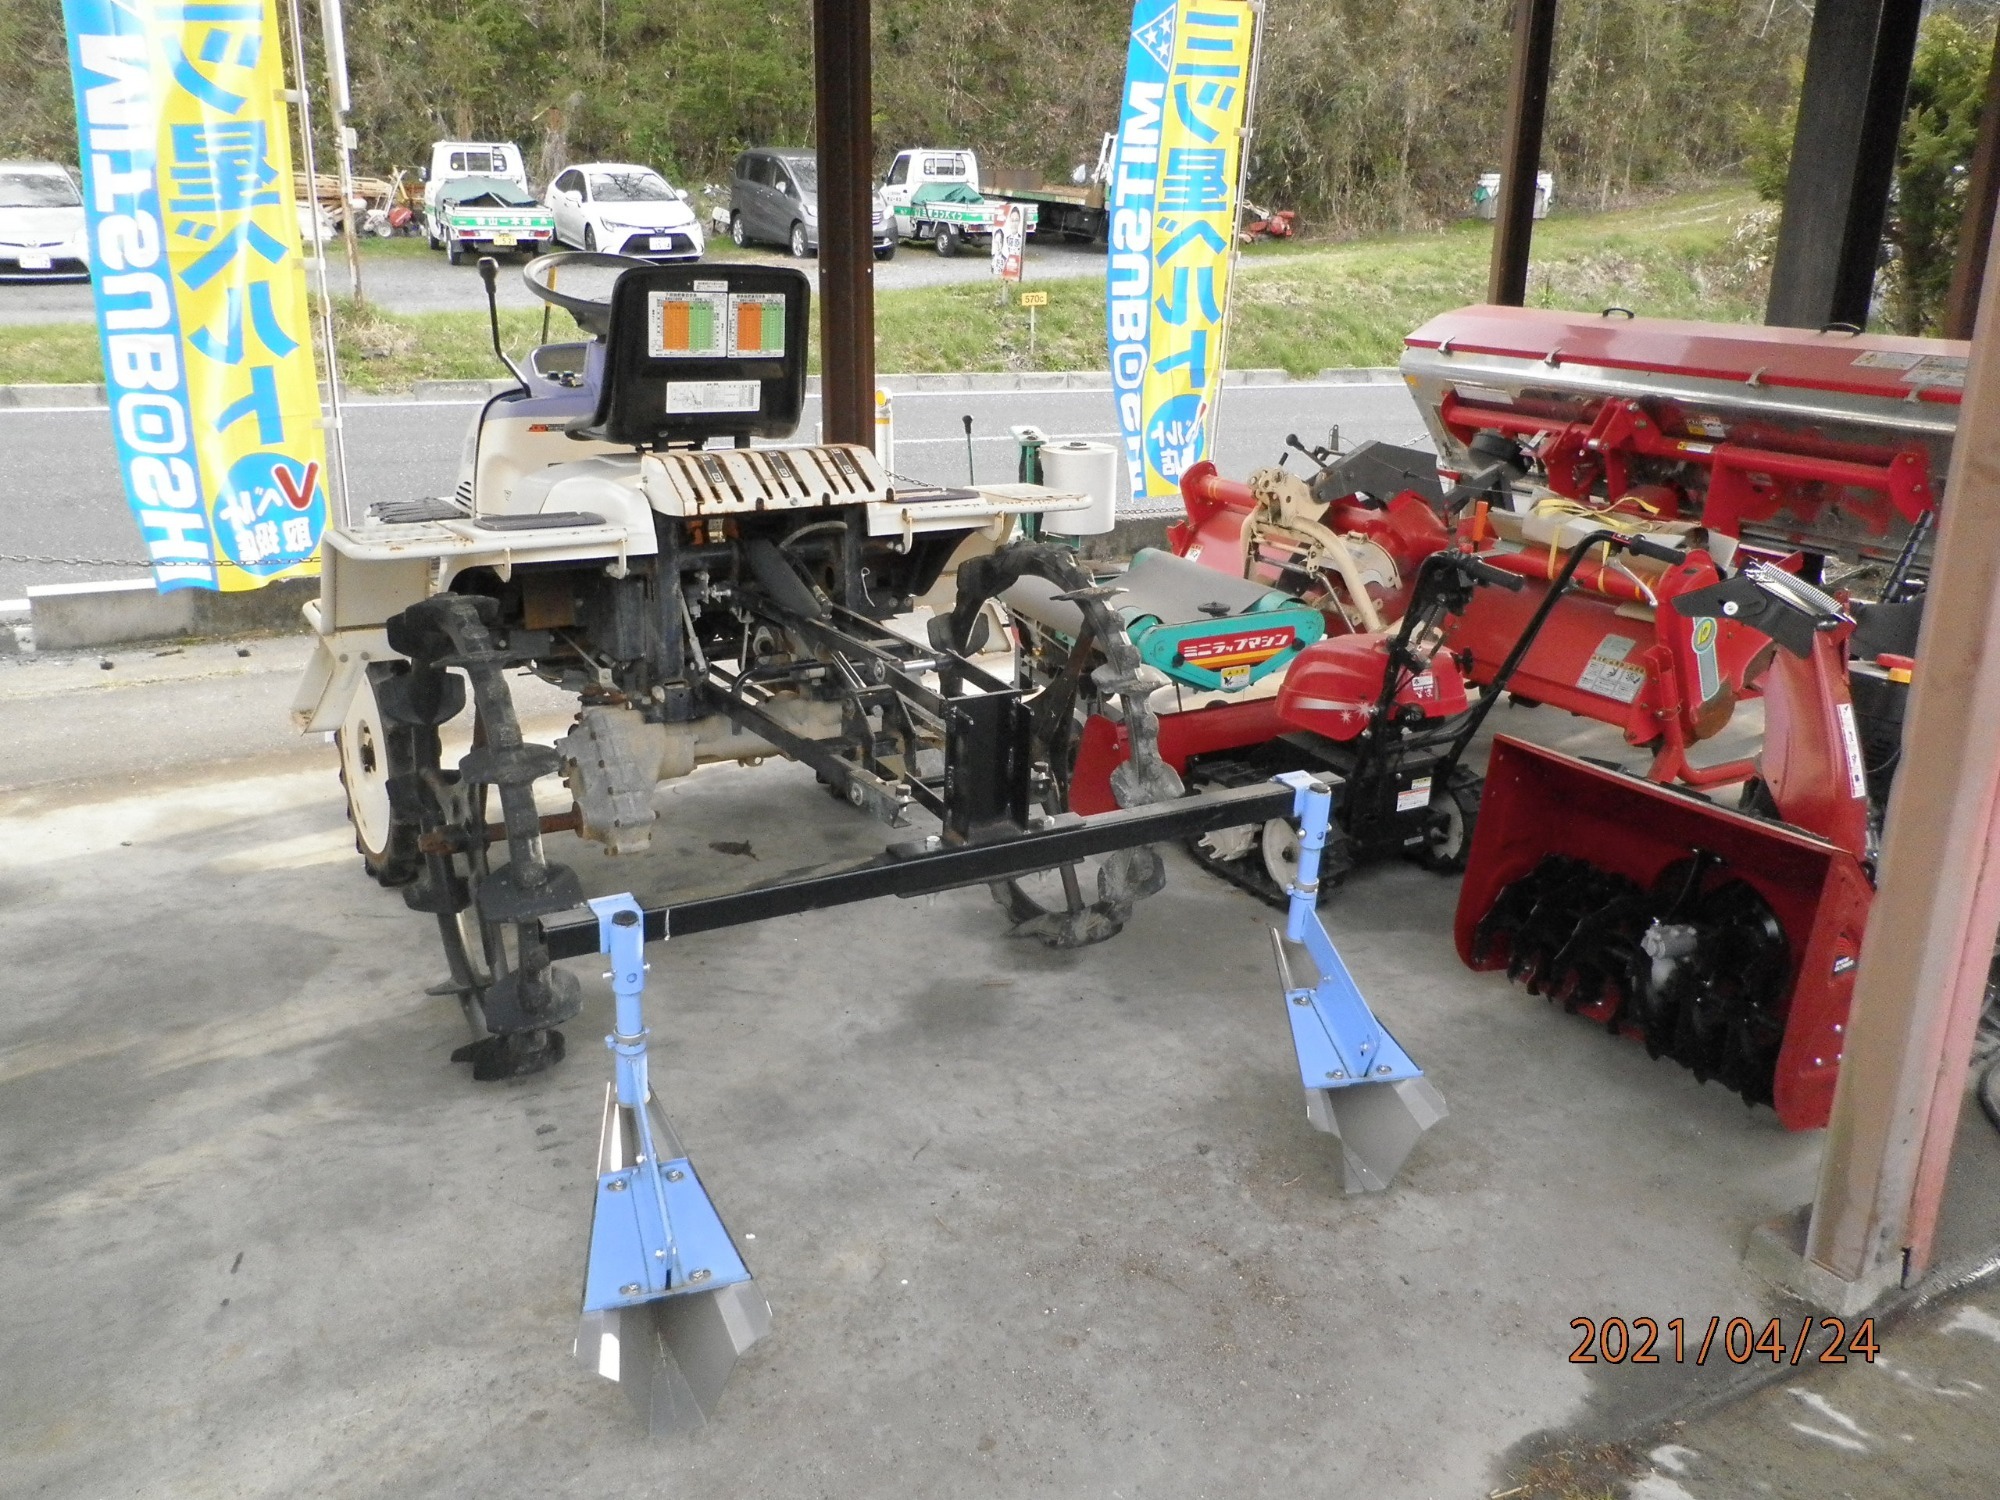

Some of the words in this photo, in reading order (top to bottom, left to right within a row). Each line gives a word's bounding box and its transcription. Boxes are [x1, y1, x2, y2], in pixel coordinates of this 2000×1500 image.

[1024, 294, 1044, 304] 570c
[1183, 634, 1289, 658] ミニラップマシン
